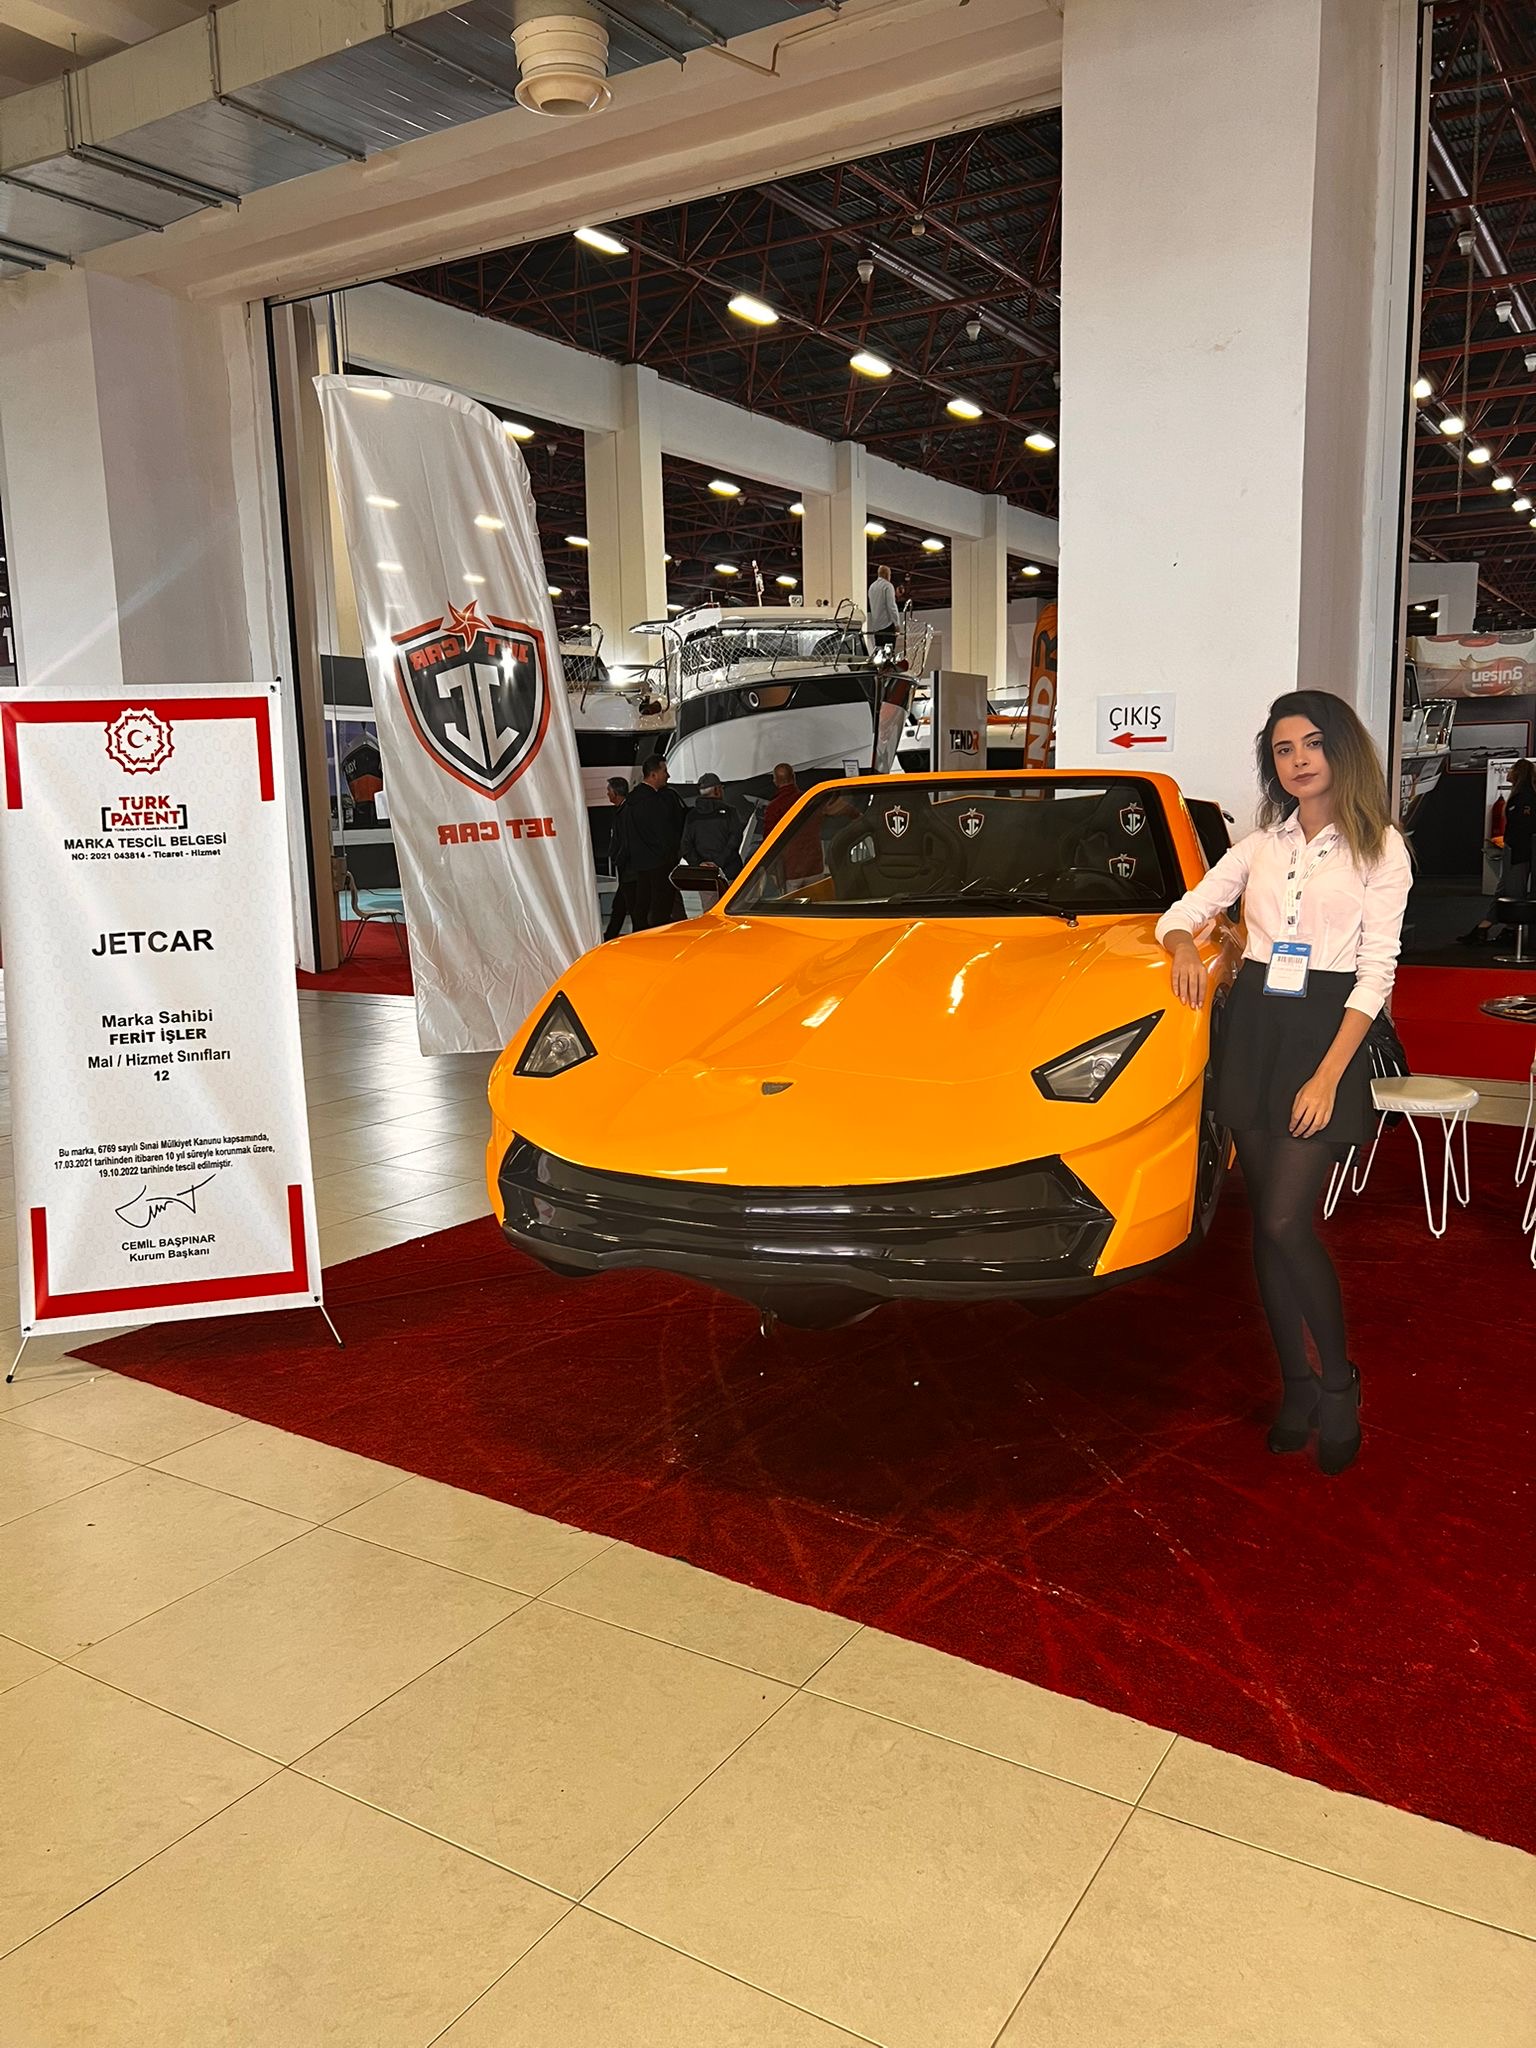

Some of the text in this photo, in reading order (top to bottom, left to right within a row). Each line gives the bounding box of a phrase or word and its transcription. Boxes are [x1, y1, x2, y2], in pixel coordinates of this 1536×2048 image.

[1471, 665, 1523, 685] gülsan
[1027, 630, 1057, 768] NDR
[1109, 705, 1162, 731] ÇIKIŞ
[118, 795, 171, 810] TÜRK
[111, 810, 180, 826] PATENT
[64, 832, 226, 850] MARKA TESCİL BELGESİ
[92, 929, 214, 956] JETCAR
[102, 1009, 213, 1028] Marka Sahibi
[110, 1028, 207, 1045] FERİT İŞLER
[88, 1055, 113, 1069] Mal
[126, 1052, 174, 1066] Hizmet
[177, 1048, 230, 1062] Sınıfları
[154, 1070, 170, 1081] 12
[59, 1148, 69, 1157] Bu
[71, 1146, 96, 1156] marka,
[98, 1144, 116, 1154] 6769
[118, 1143, 138, 1153] sayılı
[161, 1139, 192, 1149] Mülkiyet
[193, 1137, 221, 1146] Kanunu
[223, 1133, 269, 1145] kapsamında,
[54, 1158, 92, 1169] 17.03.2021
[94, 1156, 133, 1166] tarihinden
[135, 1154, 164, 1163] itibaren
[165, 1151, 174, 1160] 10
[186, 1149, 214, 1159] süreyle
[215, 1145, 252, 1156] korunmak
[253, 1144, 275, 1153] üzere,
[99, 1166, 139, 1178] 19.10.2022
[140, 1164, 174, 1174] tarihinde
[175, 1162, 196, 1171] tescil
[122, 1234, 216, 1251] CEMİL BAŞPINAR
[129, 1248, 209, 1262] Kurum Başkanı
